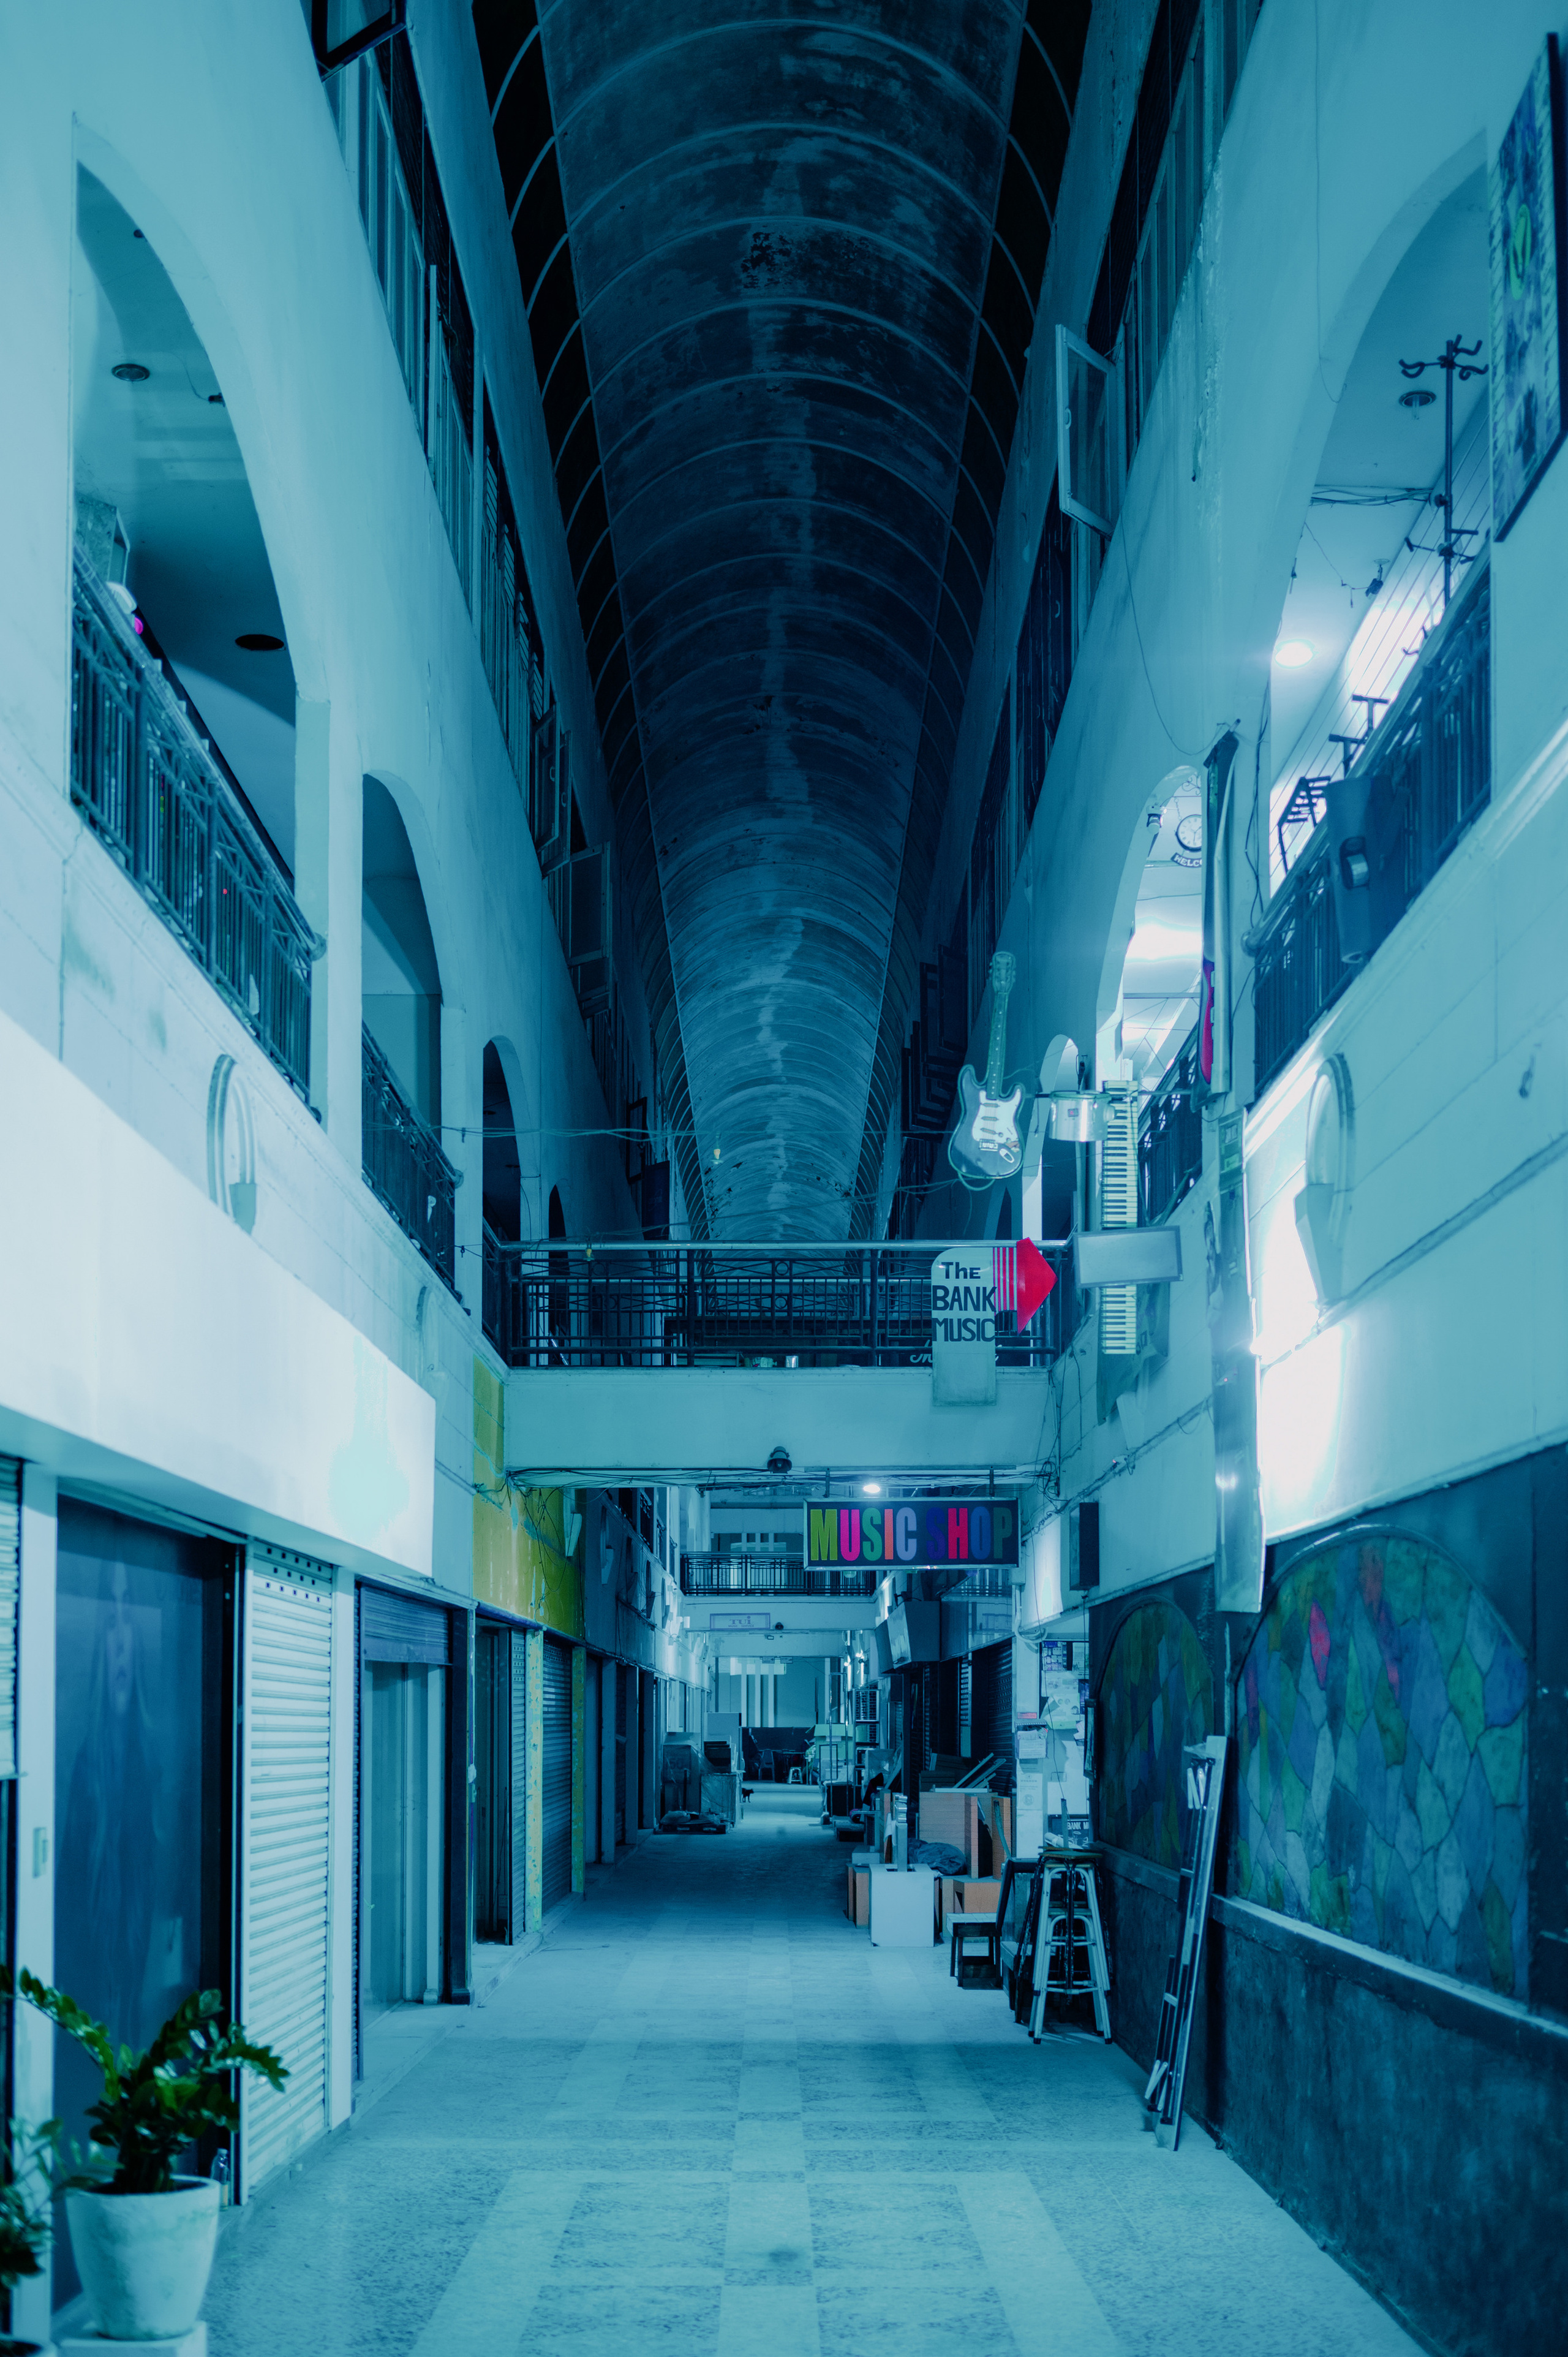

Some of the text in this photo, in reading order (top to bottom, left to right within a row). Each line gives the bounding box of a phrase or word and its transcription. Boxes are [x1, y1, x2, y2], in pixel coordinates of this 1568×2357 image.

[932, 1285, 997, 1312] BANK
[932, 1318, 995, 1342] MUSIC
[810, 1507, 1013, 1561] MUSIC SHOP
